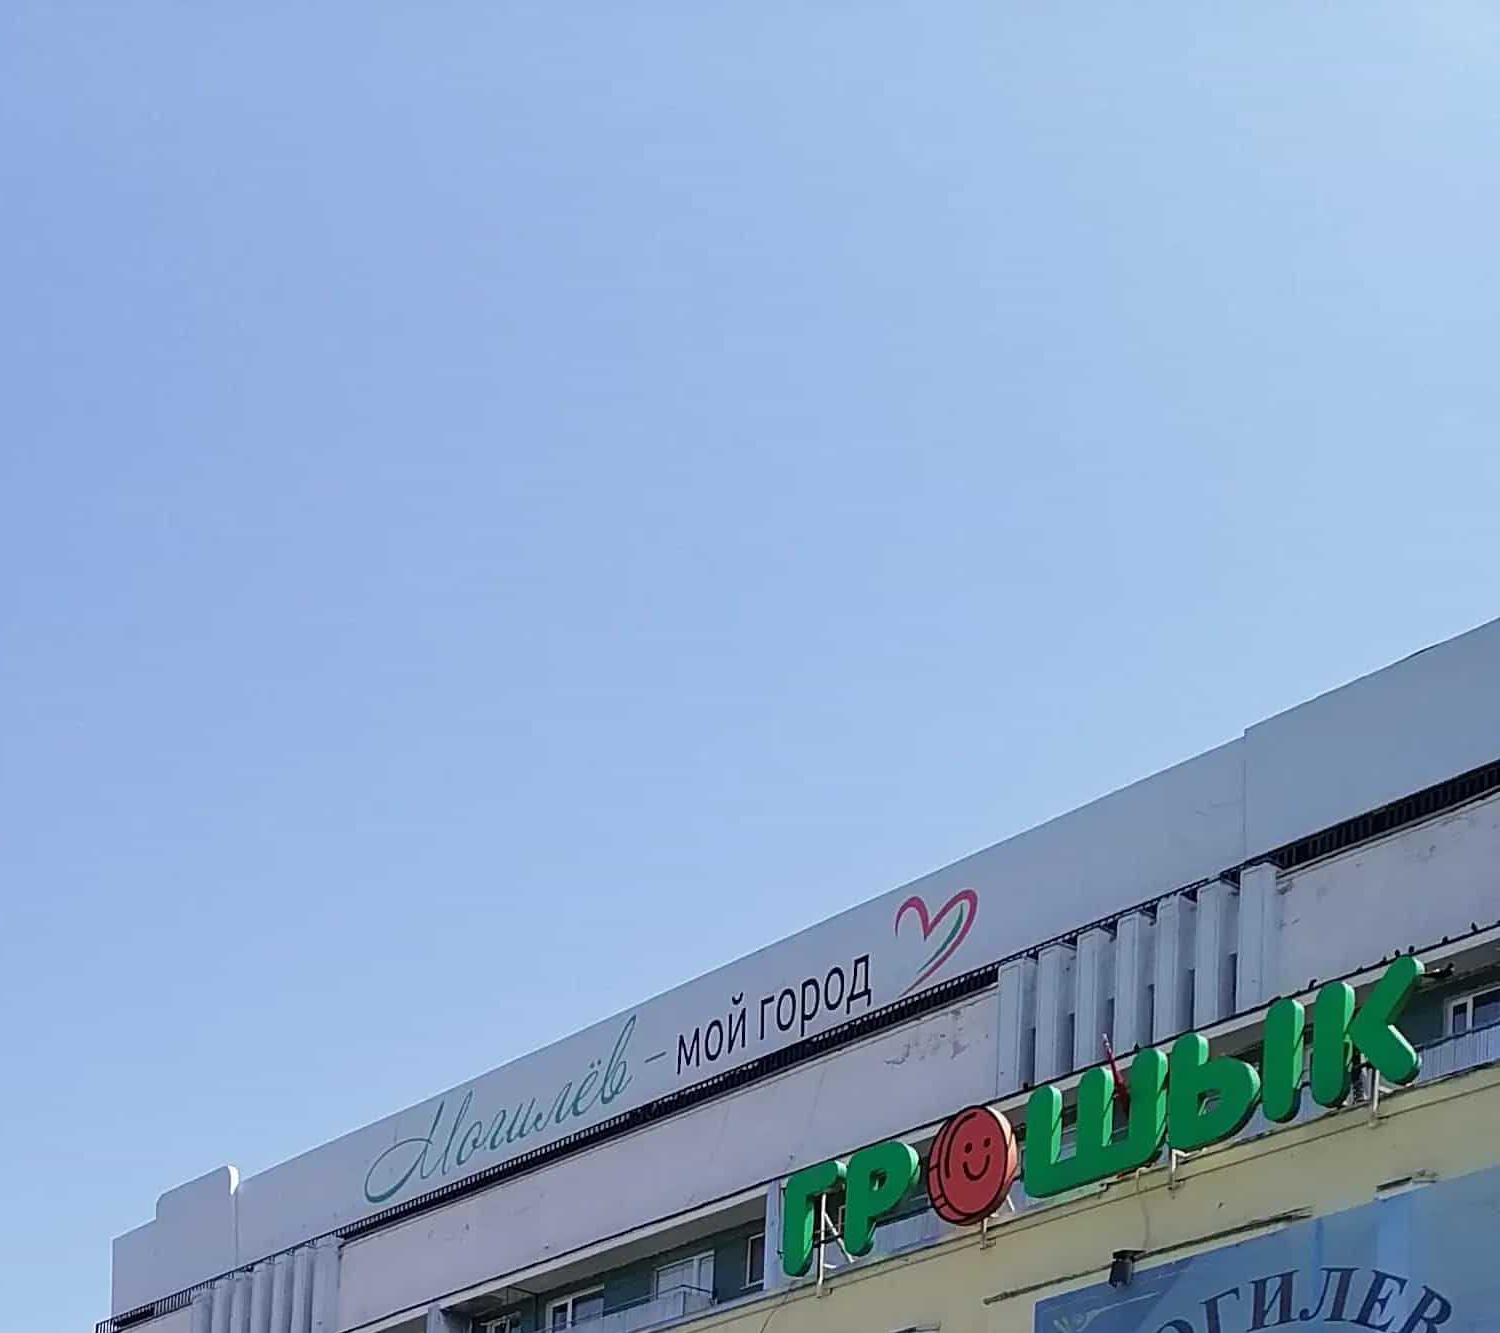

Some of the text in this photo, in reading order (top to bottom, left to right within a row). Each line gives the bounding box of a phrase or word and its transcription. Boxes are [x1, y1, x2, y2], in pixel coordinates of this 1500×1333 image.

[363, 1014, 638, 1203] Могилёв
[675, 991, 747, 1075] мой
[759, 953, 874, 1042] город
[782, 954, 1426, 1277] ГРОШЫК
